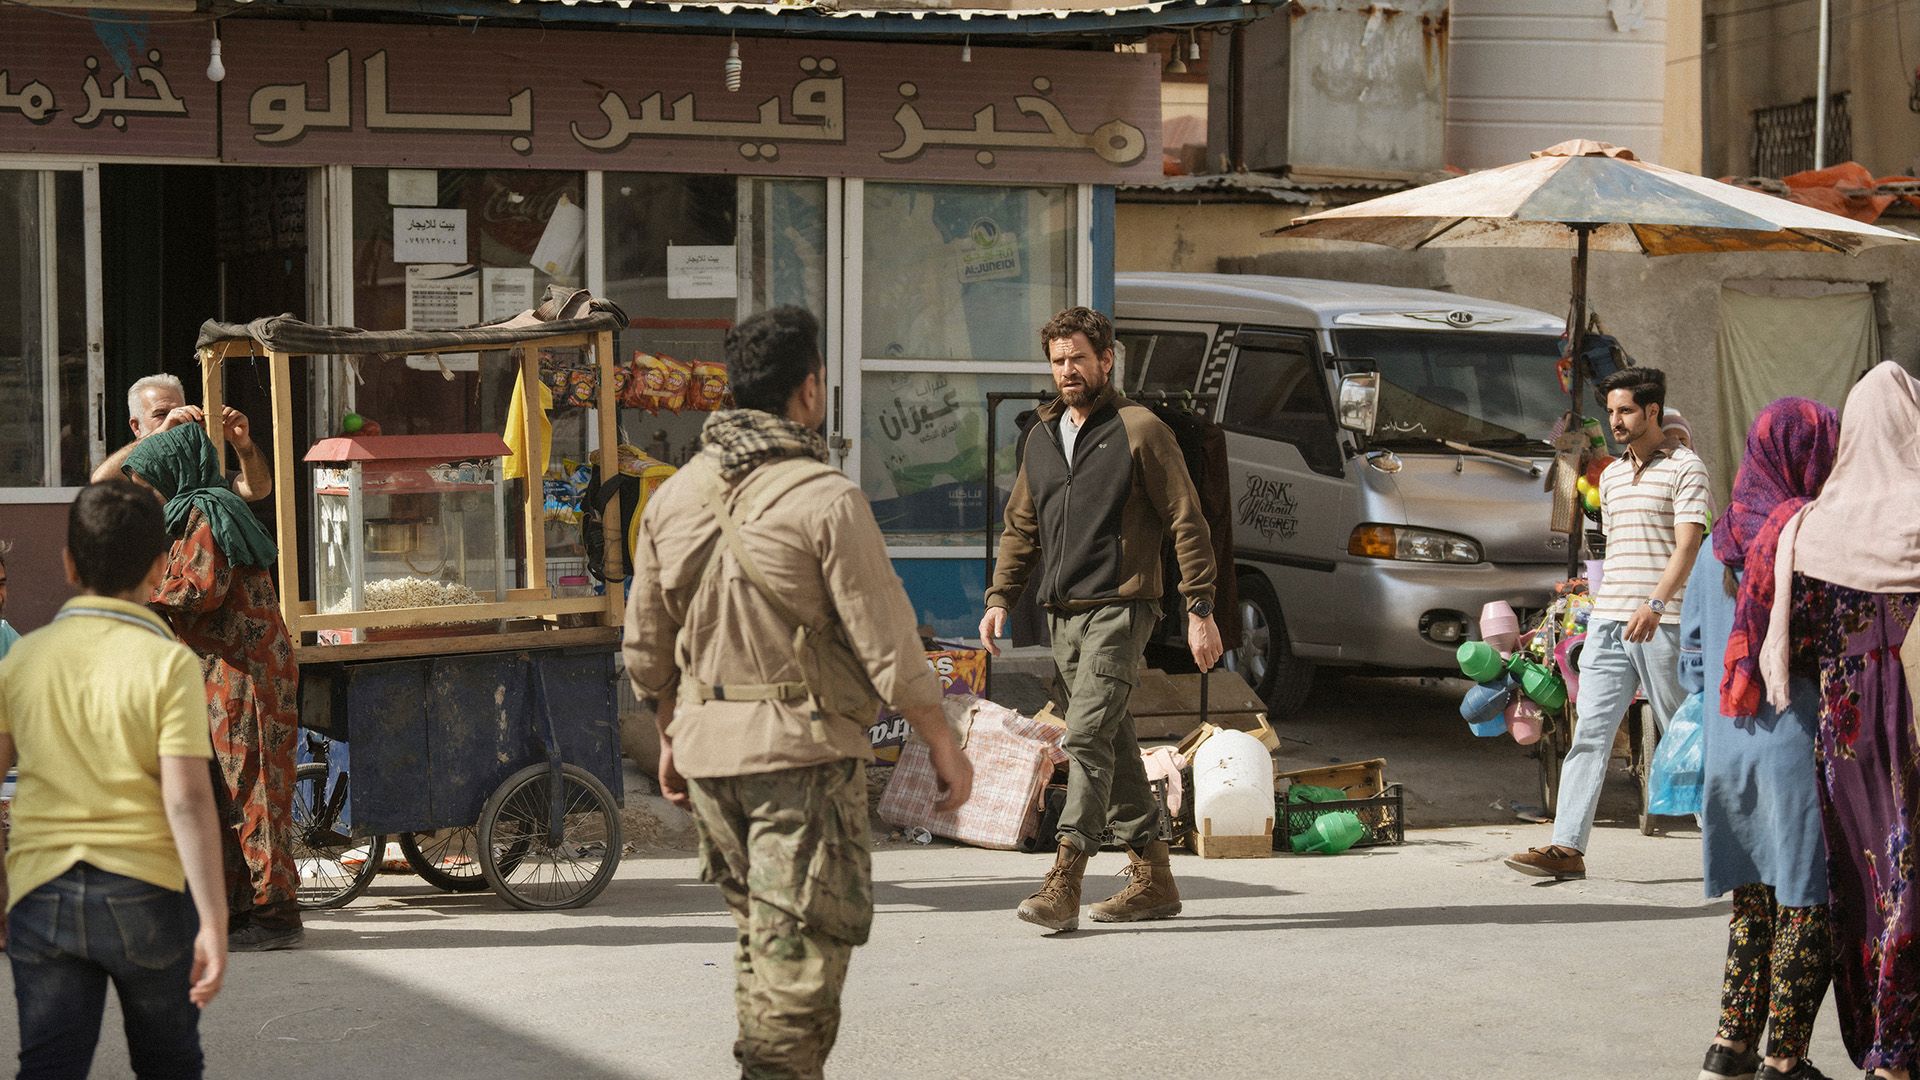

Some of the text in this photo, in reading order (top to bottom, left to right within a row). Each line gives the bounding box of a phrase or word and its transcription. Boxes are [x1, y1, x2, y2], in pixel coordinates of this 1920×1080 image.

[72, 49, 188, 127] خبز
[249, 48, 1146, 167] مخبز قيس بالو
[439, 220, 456, 231] بيت
[965, 257, 1016, 275] AL-JUNEIDI
[1450, 312, 1470, 322] JK
[879, 388, 960, 441] عيران
[1247, 475, 1293, 504] RISK
[1238, 496, 1298, 526] Without
[1254, 514, 1298, 536] REGRET
